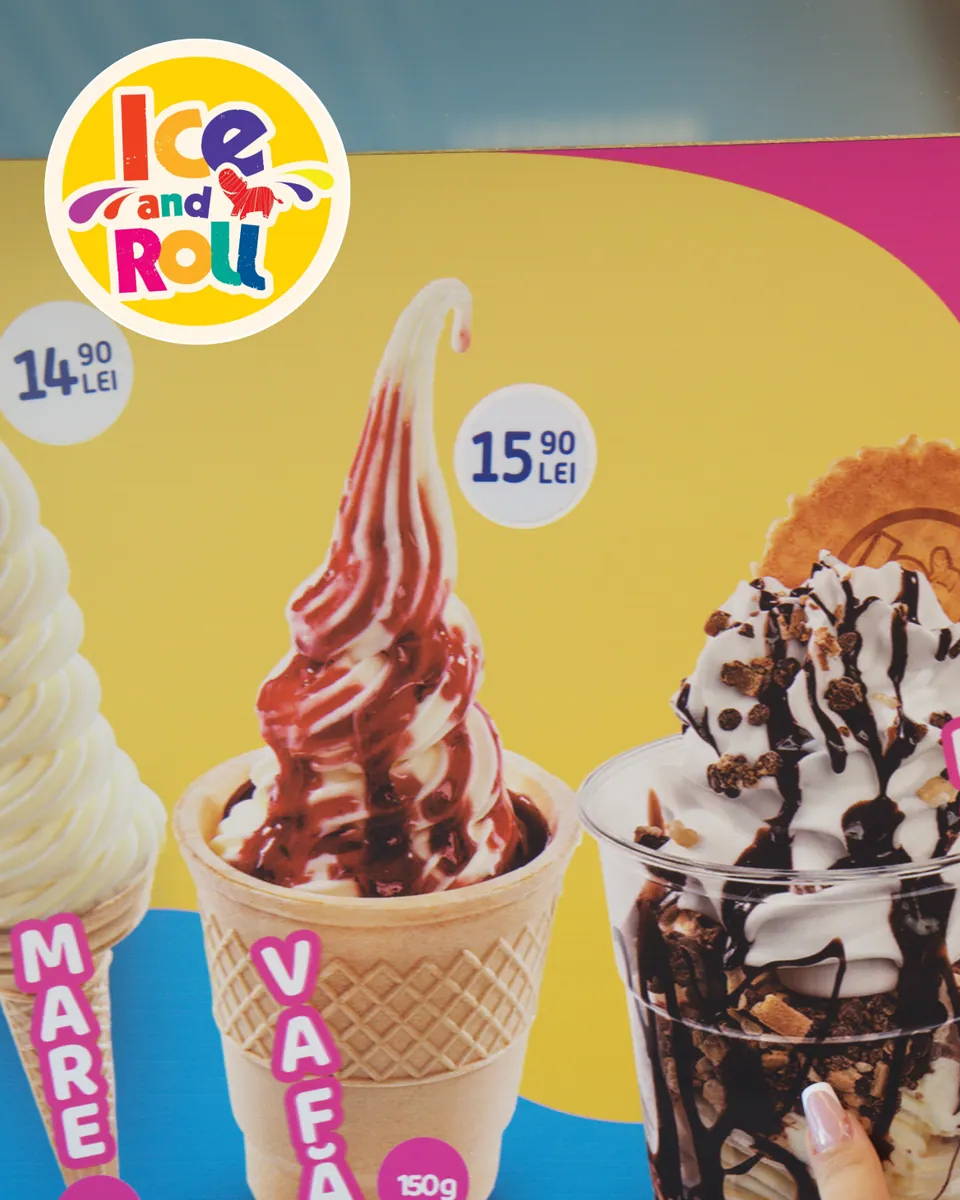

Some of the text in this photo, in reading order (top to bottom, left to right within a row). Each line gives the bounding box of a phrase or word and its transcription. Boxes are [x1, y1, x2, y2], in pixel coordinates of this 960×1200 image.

[13, 340, 113, 401] 14 90
[81, 369, 117, 395] LEI
[471, 430, 576, 483] 15 90
[539, 462, 576, 484] LEI
[20, 922, 106, 1159] MARE
